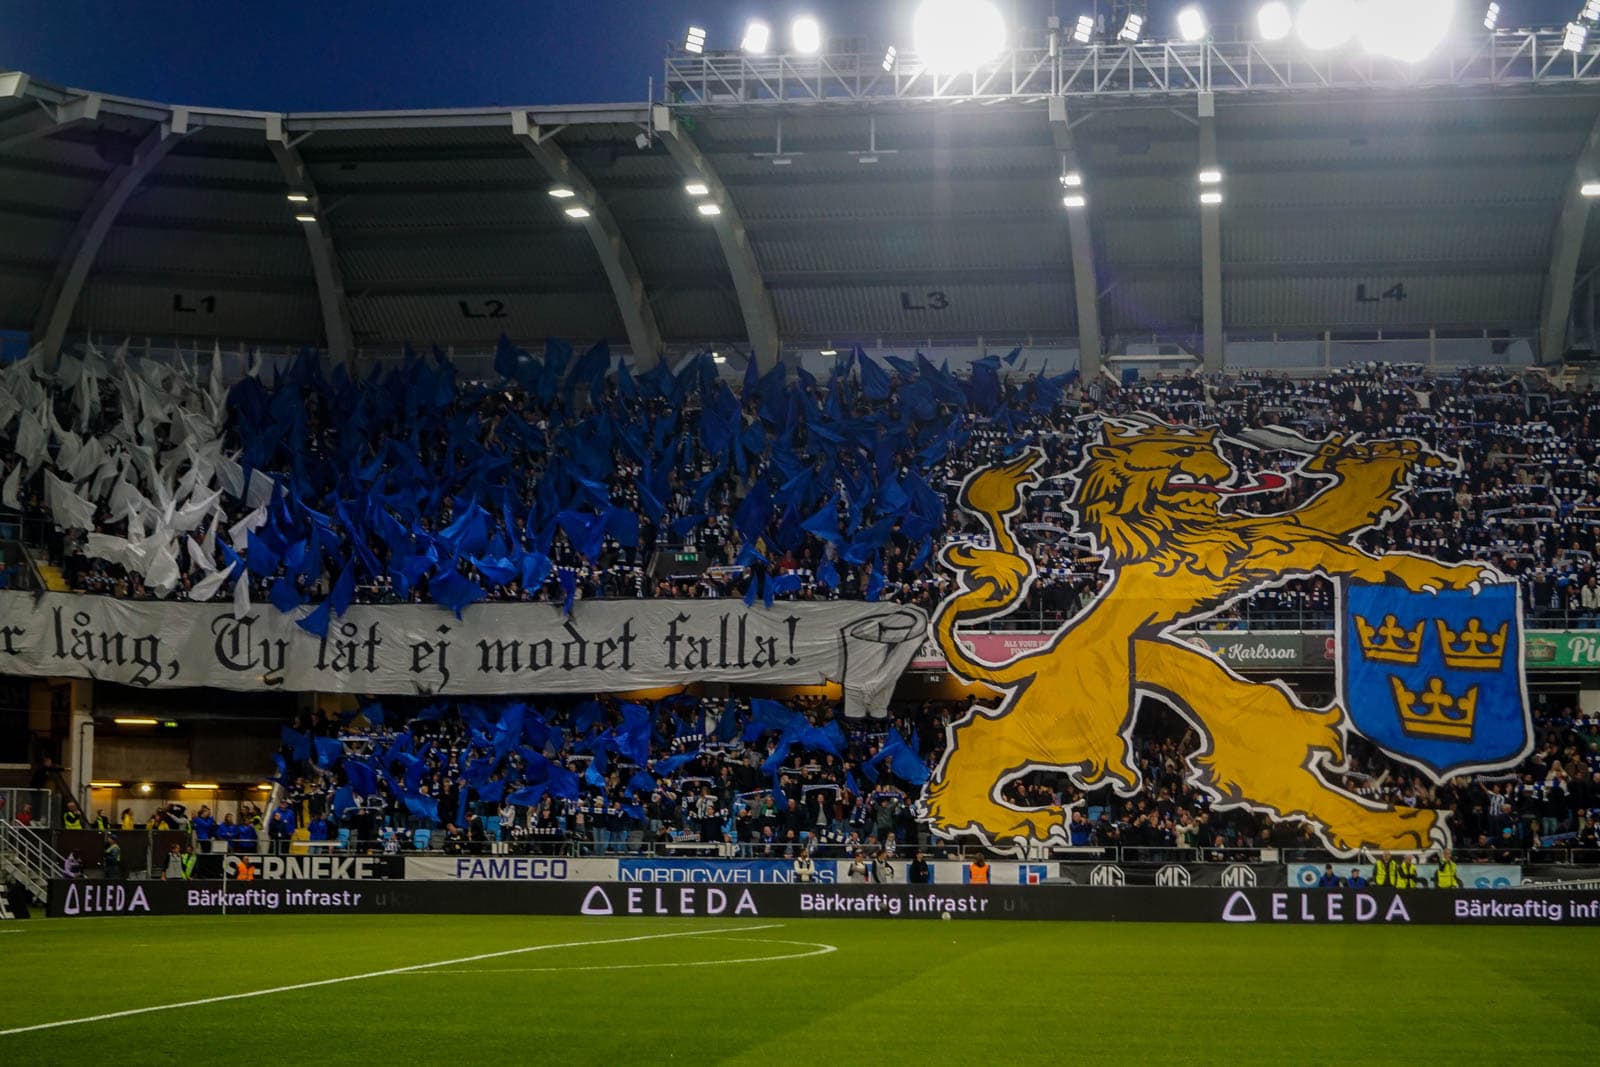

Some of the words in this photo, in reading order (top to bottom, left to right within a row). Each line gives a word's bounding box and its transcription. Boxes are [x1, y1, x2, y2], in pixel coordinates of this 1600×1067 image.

[901, 292, 948, 309] L3
[1357, 283, 1407, 301] L4
[174, 294, 215, 312] L1
[459, 301, 507, 318] L2
[53, 606, 180, 687] lång,
[409, 624, 451, 692] ej
[477, 614, 637, 674] modet
[664, 611, 800, 671] falla!
[1228, 643, 1297, 661] Karlsson
[457, 859, 568, 879] FAMECO
[84, 885, 150, 912] ELEDA
[188, 888, 279, 908] Bärkraftig
[628, 888, 758, 914] ELEDA
[801, 893, 900, 914] Bärkraftig
[1272, 893, 1410, 921] ELEDA
[1455, 899, 1562, 920] Bärkraftig
[1570, 901, 1600, 917] inf
